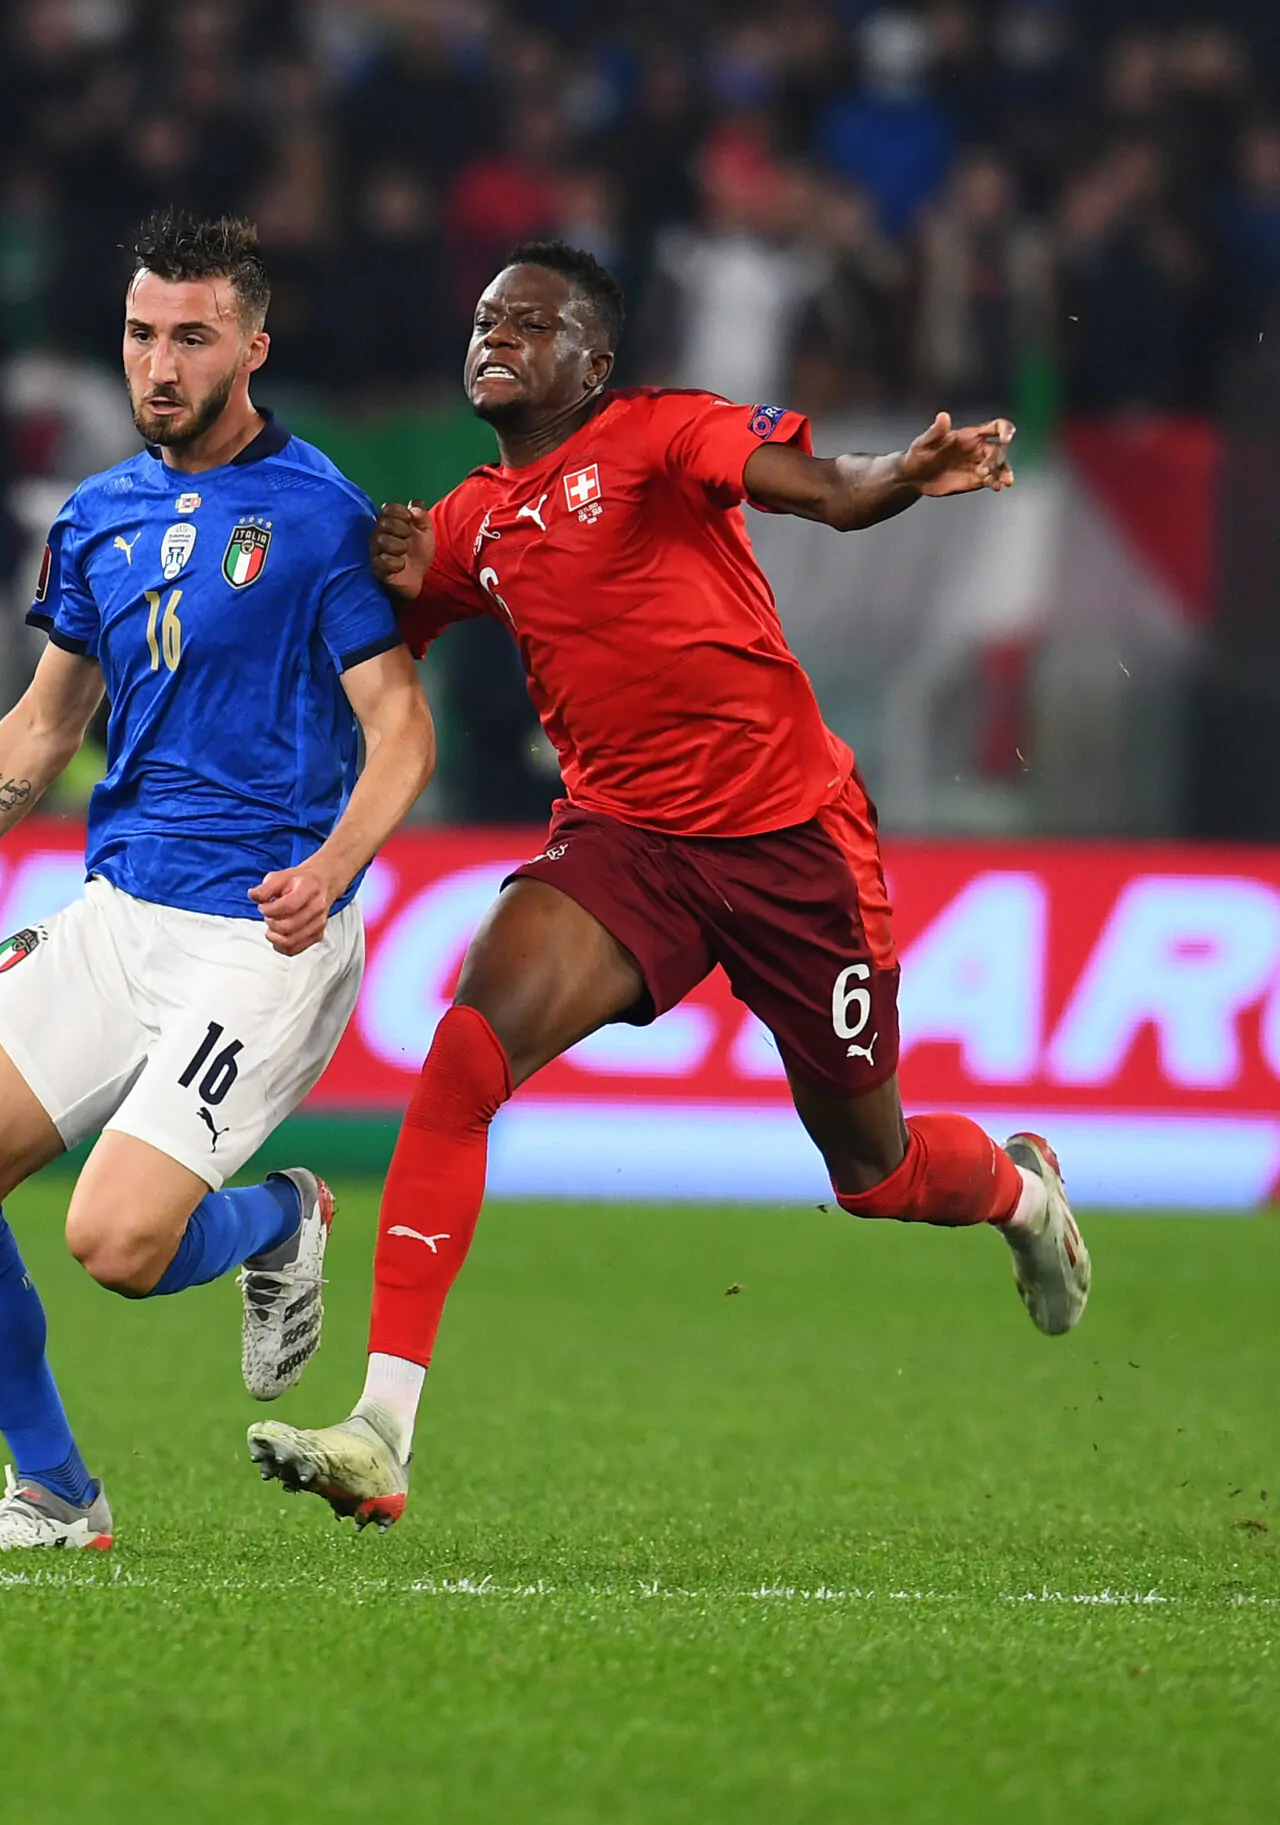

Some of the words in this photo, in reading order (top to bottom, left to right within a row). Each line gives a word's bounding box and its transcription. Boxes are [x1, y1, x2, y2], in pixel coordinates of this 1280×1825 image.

[234, 530, 267, 544] ITALIA
[144, 589, 184, 672] 16
[832, 963, 871, 1039] 6
[177, 1020, 245, 1106] 16
